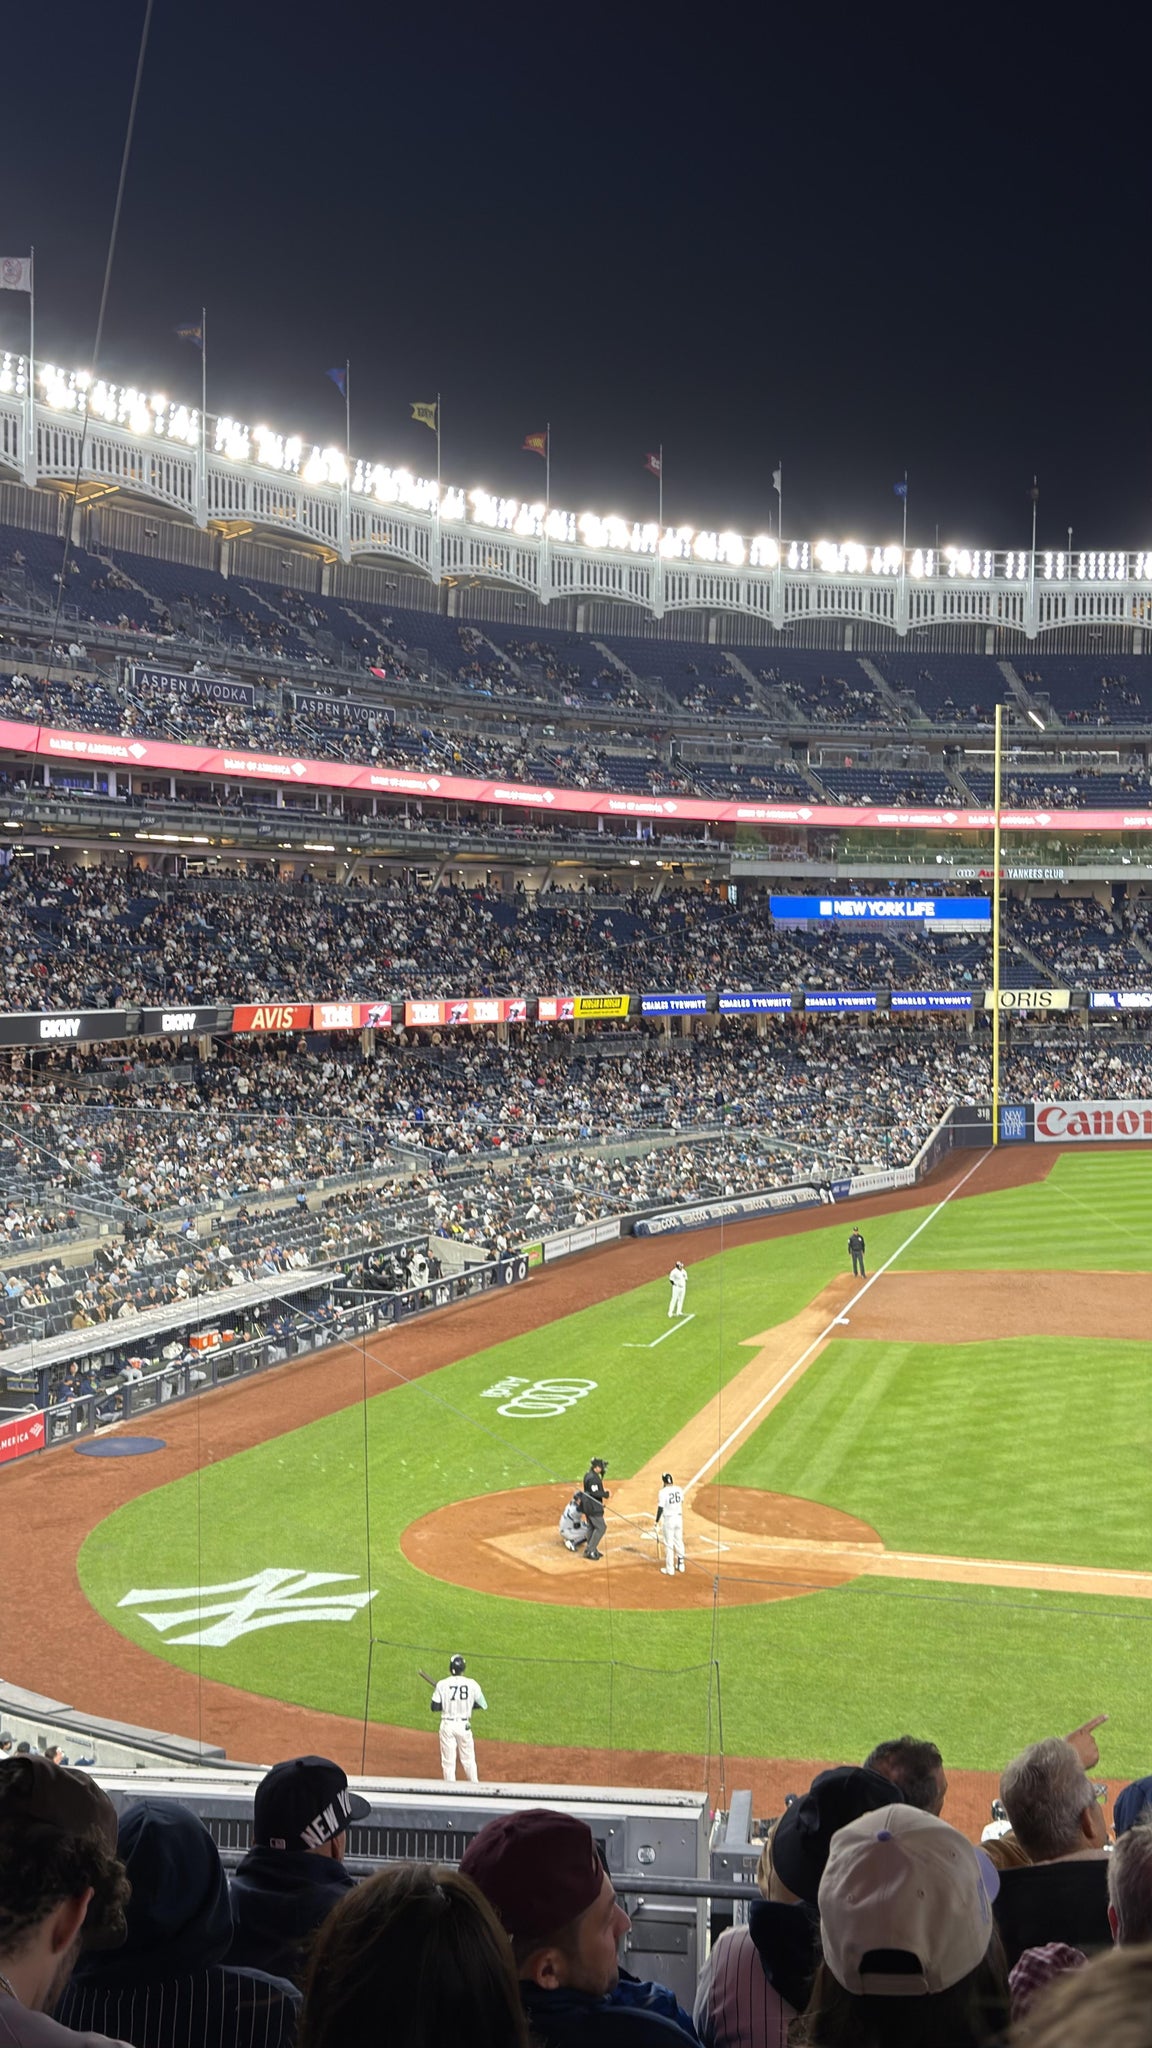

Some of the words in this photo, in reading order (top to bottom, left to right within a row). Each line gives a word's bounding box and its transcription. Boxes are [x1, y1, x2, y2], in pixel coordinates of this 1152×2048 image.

[141, 673, 187, 691] ASPEN
[204, 683, 248, 702] VODKA
[301, 700, 340, 715] ASPEN
[1007, 869, 1043, 879] YANKEES
[1044, 869, 1064, 879] CLUB
[834, 901, 868, 916] NEW
[868, 901, 906, 916] YORK
[906, 901, 935, 917] LIFE
[1001, 991, 1053, 1007] ORIS
[162, 1013, 197, 1032] DKNY
[251, 1007, 294, 1030] AVIS
[40, 1018, 81, 1039] DKNY
[1004, 1125, 1022, 1136] LIFE
[668, 1491, 681, 1505] 26
[449, 1685, 469, 1701] 78
[300, 1803, 340, 1849] NEW
